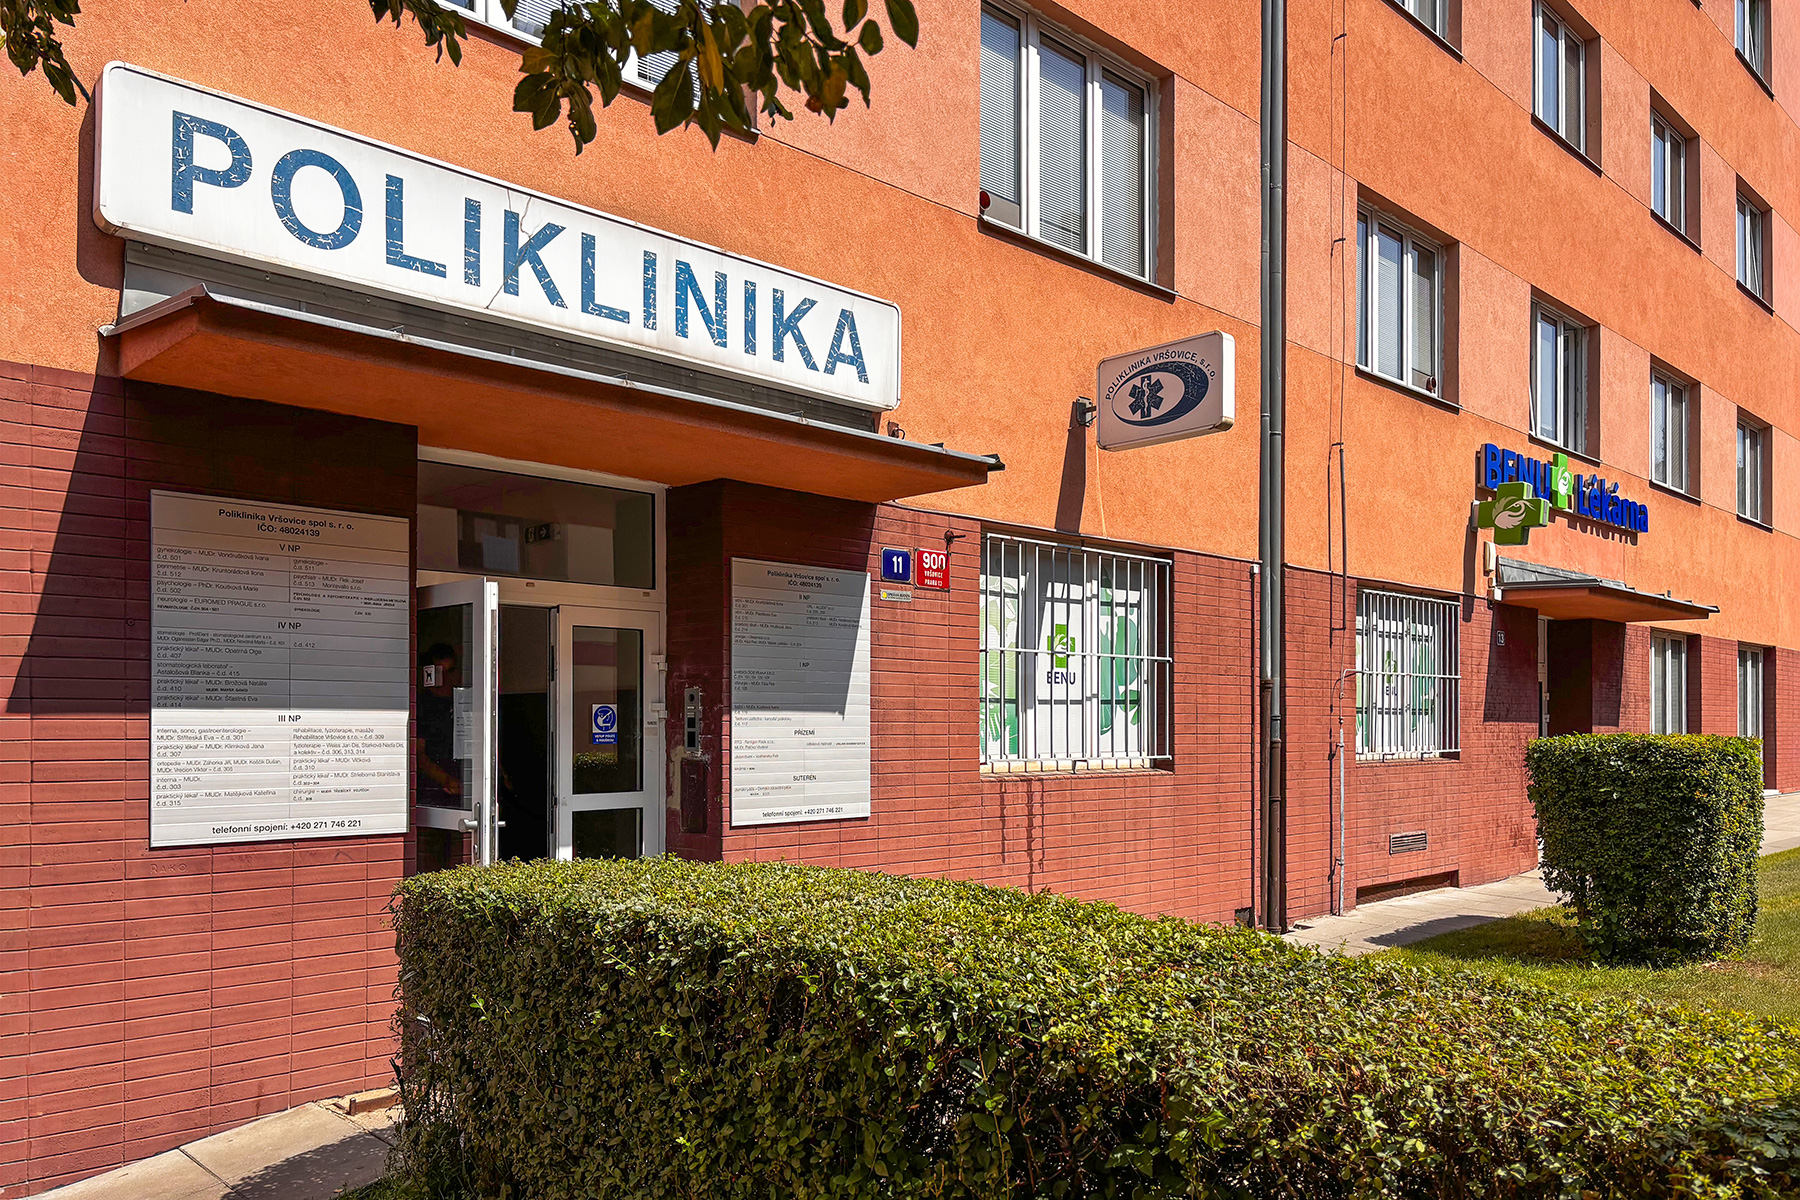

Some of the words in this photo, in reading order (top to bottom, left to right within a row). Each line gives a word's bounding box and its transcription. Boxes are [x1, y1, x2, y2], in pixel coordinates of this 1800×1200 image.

[171, 109, 870, 384] POLIKLINIKA
[1105, 356, 1152, 401] POLIKLINIKA
[1152, 349, 1198, 364] VRŠOVICE,
[1482, 443, 1551, 500] BENU
[1575, 473, 1649, 533] Lékárna
[218, 509, 266, 521] Poliklinika
[268, 513, 306, 525] Vršovice
[308, 517, 327, 528] spol
[257, 523, 278, 533] IČO:
[279, 526, 320, 537] 48024139
[157, 546, 192, 556] gynekologie
[199, 549, 216, 557] MUDr.
[157, 563, 186, 571] perimetrie
[892, 555, 903, 574] 11
[922, 552, 946, 570] 900
[767, 570, 793, 578] Poliklinika
[794, 572, 814, 580] Vršovice
[924, 570, 944, 578] VRŠOVICE
[157, 580, 192, 588] psychologie
[157, 596, 188, 604] neurologie
[194, 598, 226, 606] EUROMED
[277, 621, 288, 629] IV
[289, 622, 302, 630] NP
[1497, 632, 1505, 644] 13
[157, 645, 184, 653] praktický
[792, 774, 817, 782] SUTERÉN
[212, 825, 252, 834] telefonní
[254, 823, 288, 833] spojení:
[291, 822, 312, 830] +420
[313, 821, 328, 829] 271
[331, 820, 346, 828] 746
[150, 862, 188, 875] RAKO
